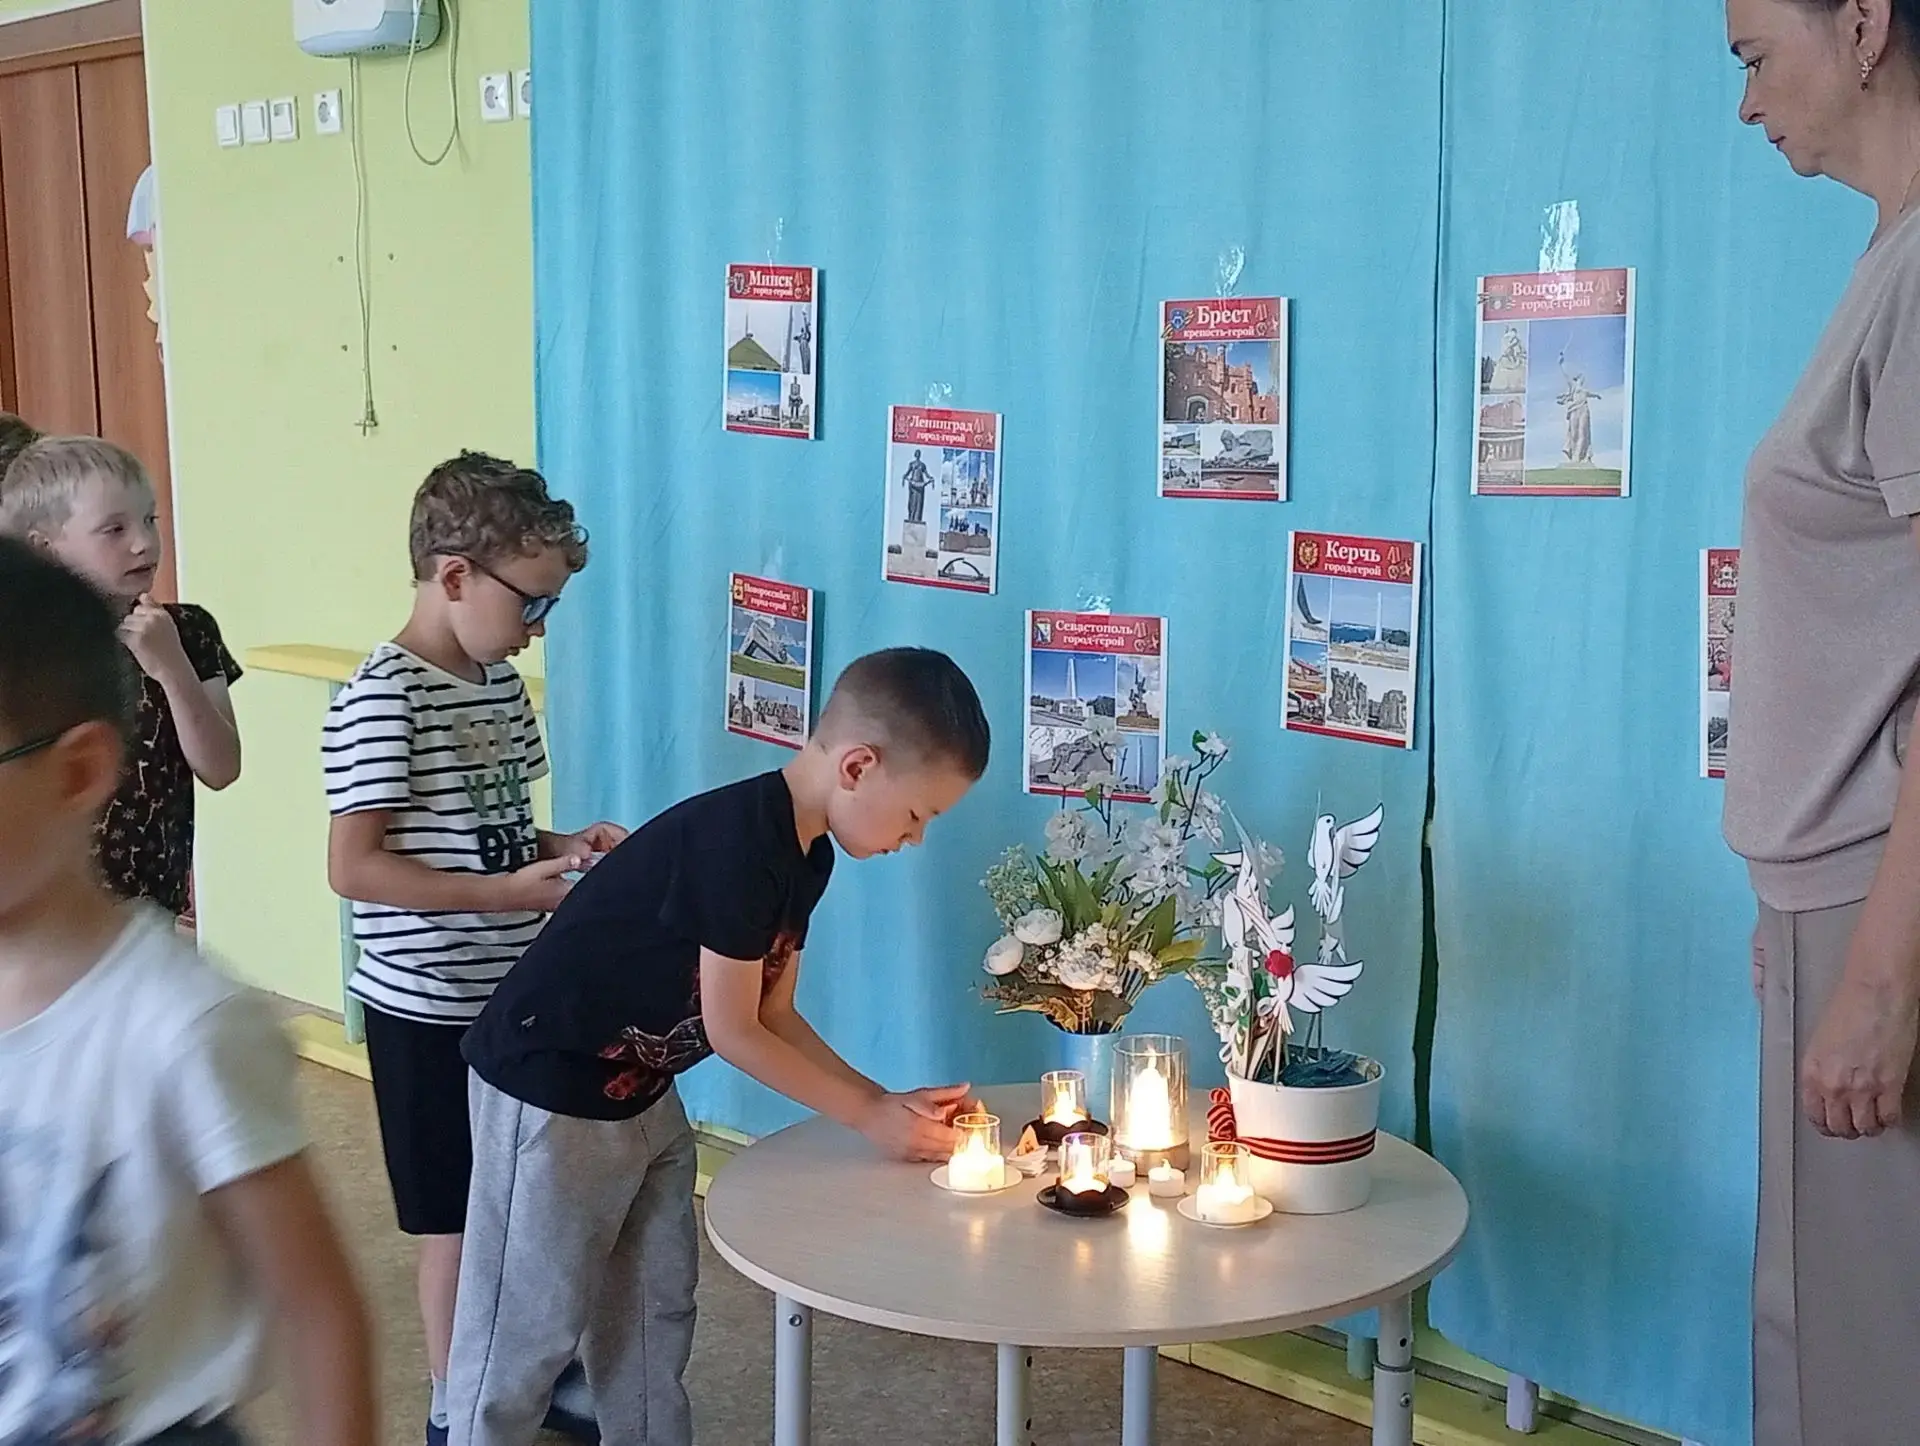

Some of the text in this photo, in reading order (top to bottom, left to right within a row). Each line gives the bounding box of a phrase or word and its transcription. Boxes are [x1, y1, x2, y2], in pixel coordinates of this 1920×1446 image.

[748, 270, 793, 287] Минск
[1521, 296, 1590, 312] город-герой
[1197, 305, 1251, 328] Брест
[1183, 326, 1255, 339] крепость-герой
[910, 415, 973, 433] Ленинград
[916, 431, 966, 443] город-герой
[1325, 540, 1380, 564] Керчь
[1324, 563, 1382, 577] город-герой
[1055, 620, 1133, 634] Севастополь
[1063, 634, 1125, 647] город-герой
